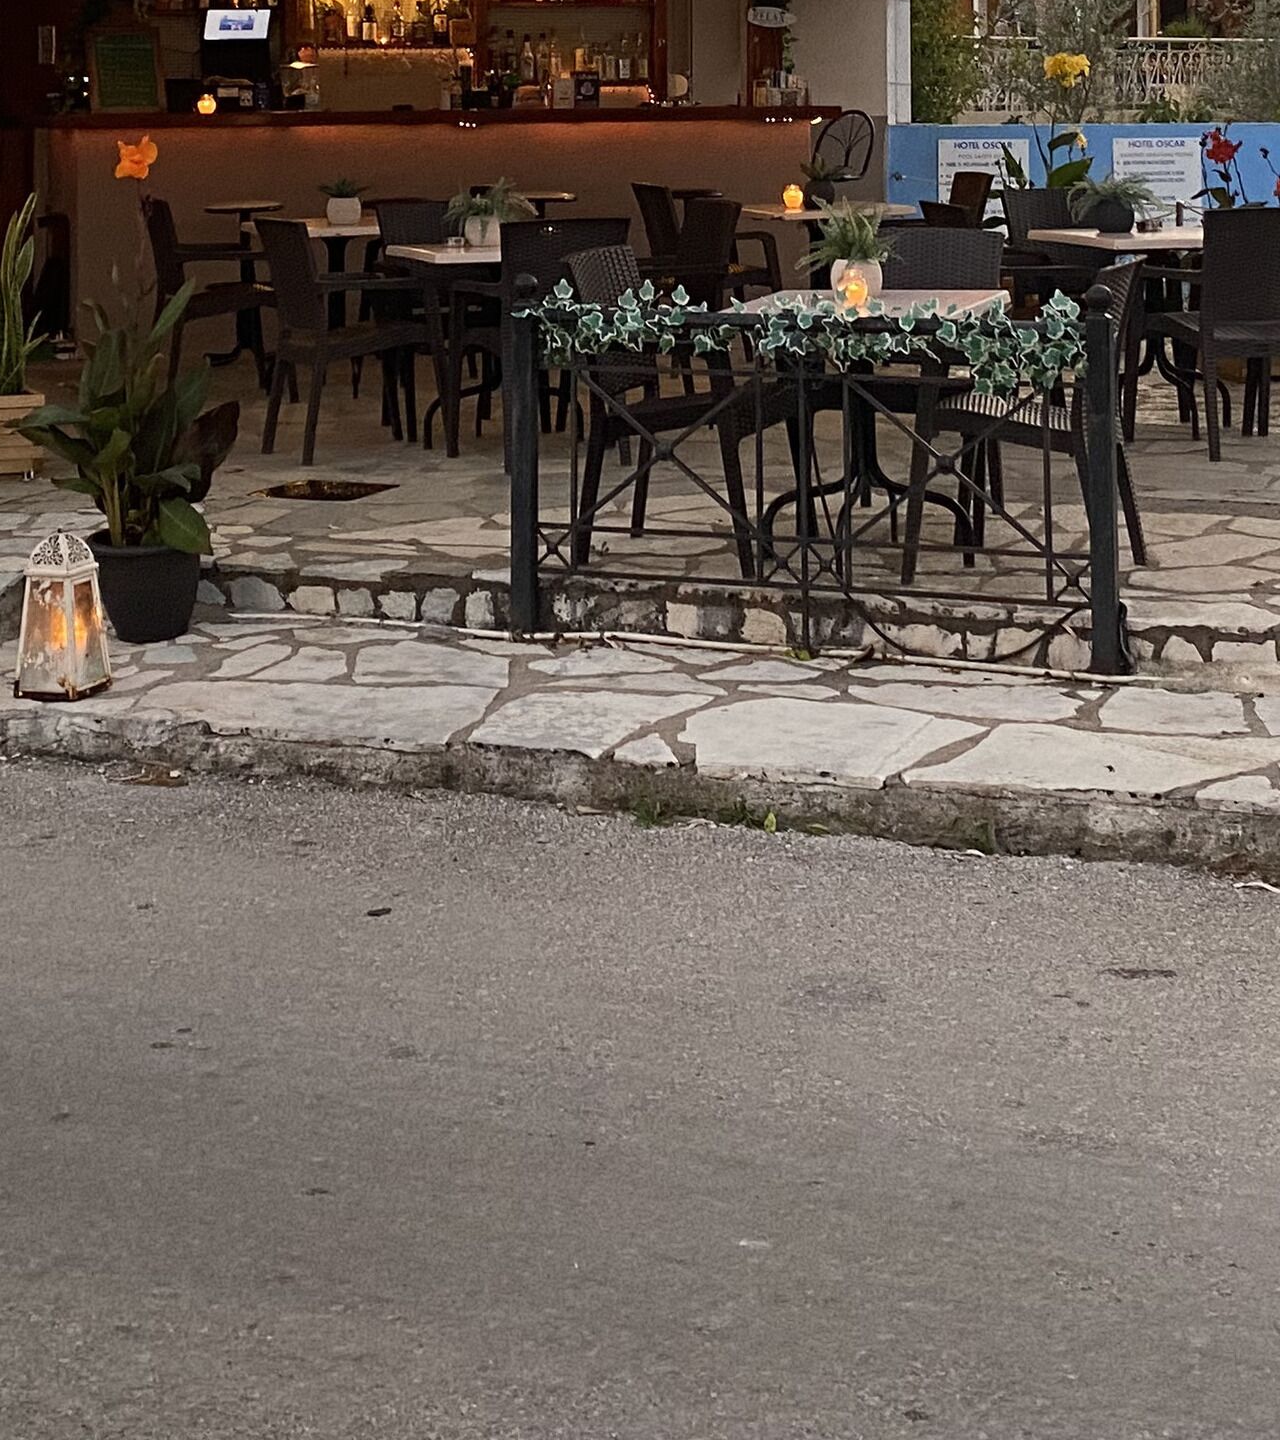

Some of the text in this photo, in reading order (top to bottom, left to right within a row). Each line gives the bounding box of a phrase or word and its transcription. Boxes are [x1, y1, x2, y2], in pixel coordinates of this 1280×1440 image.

[953, 141, 980, 150] HOTEL
[1128, 140, 1186, 148] HOTEL OSCAR
